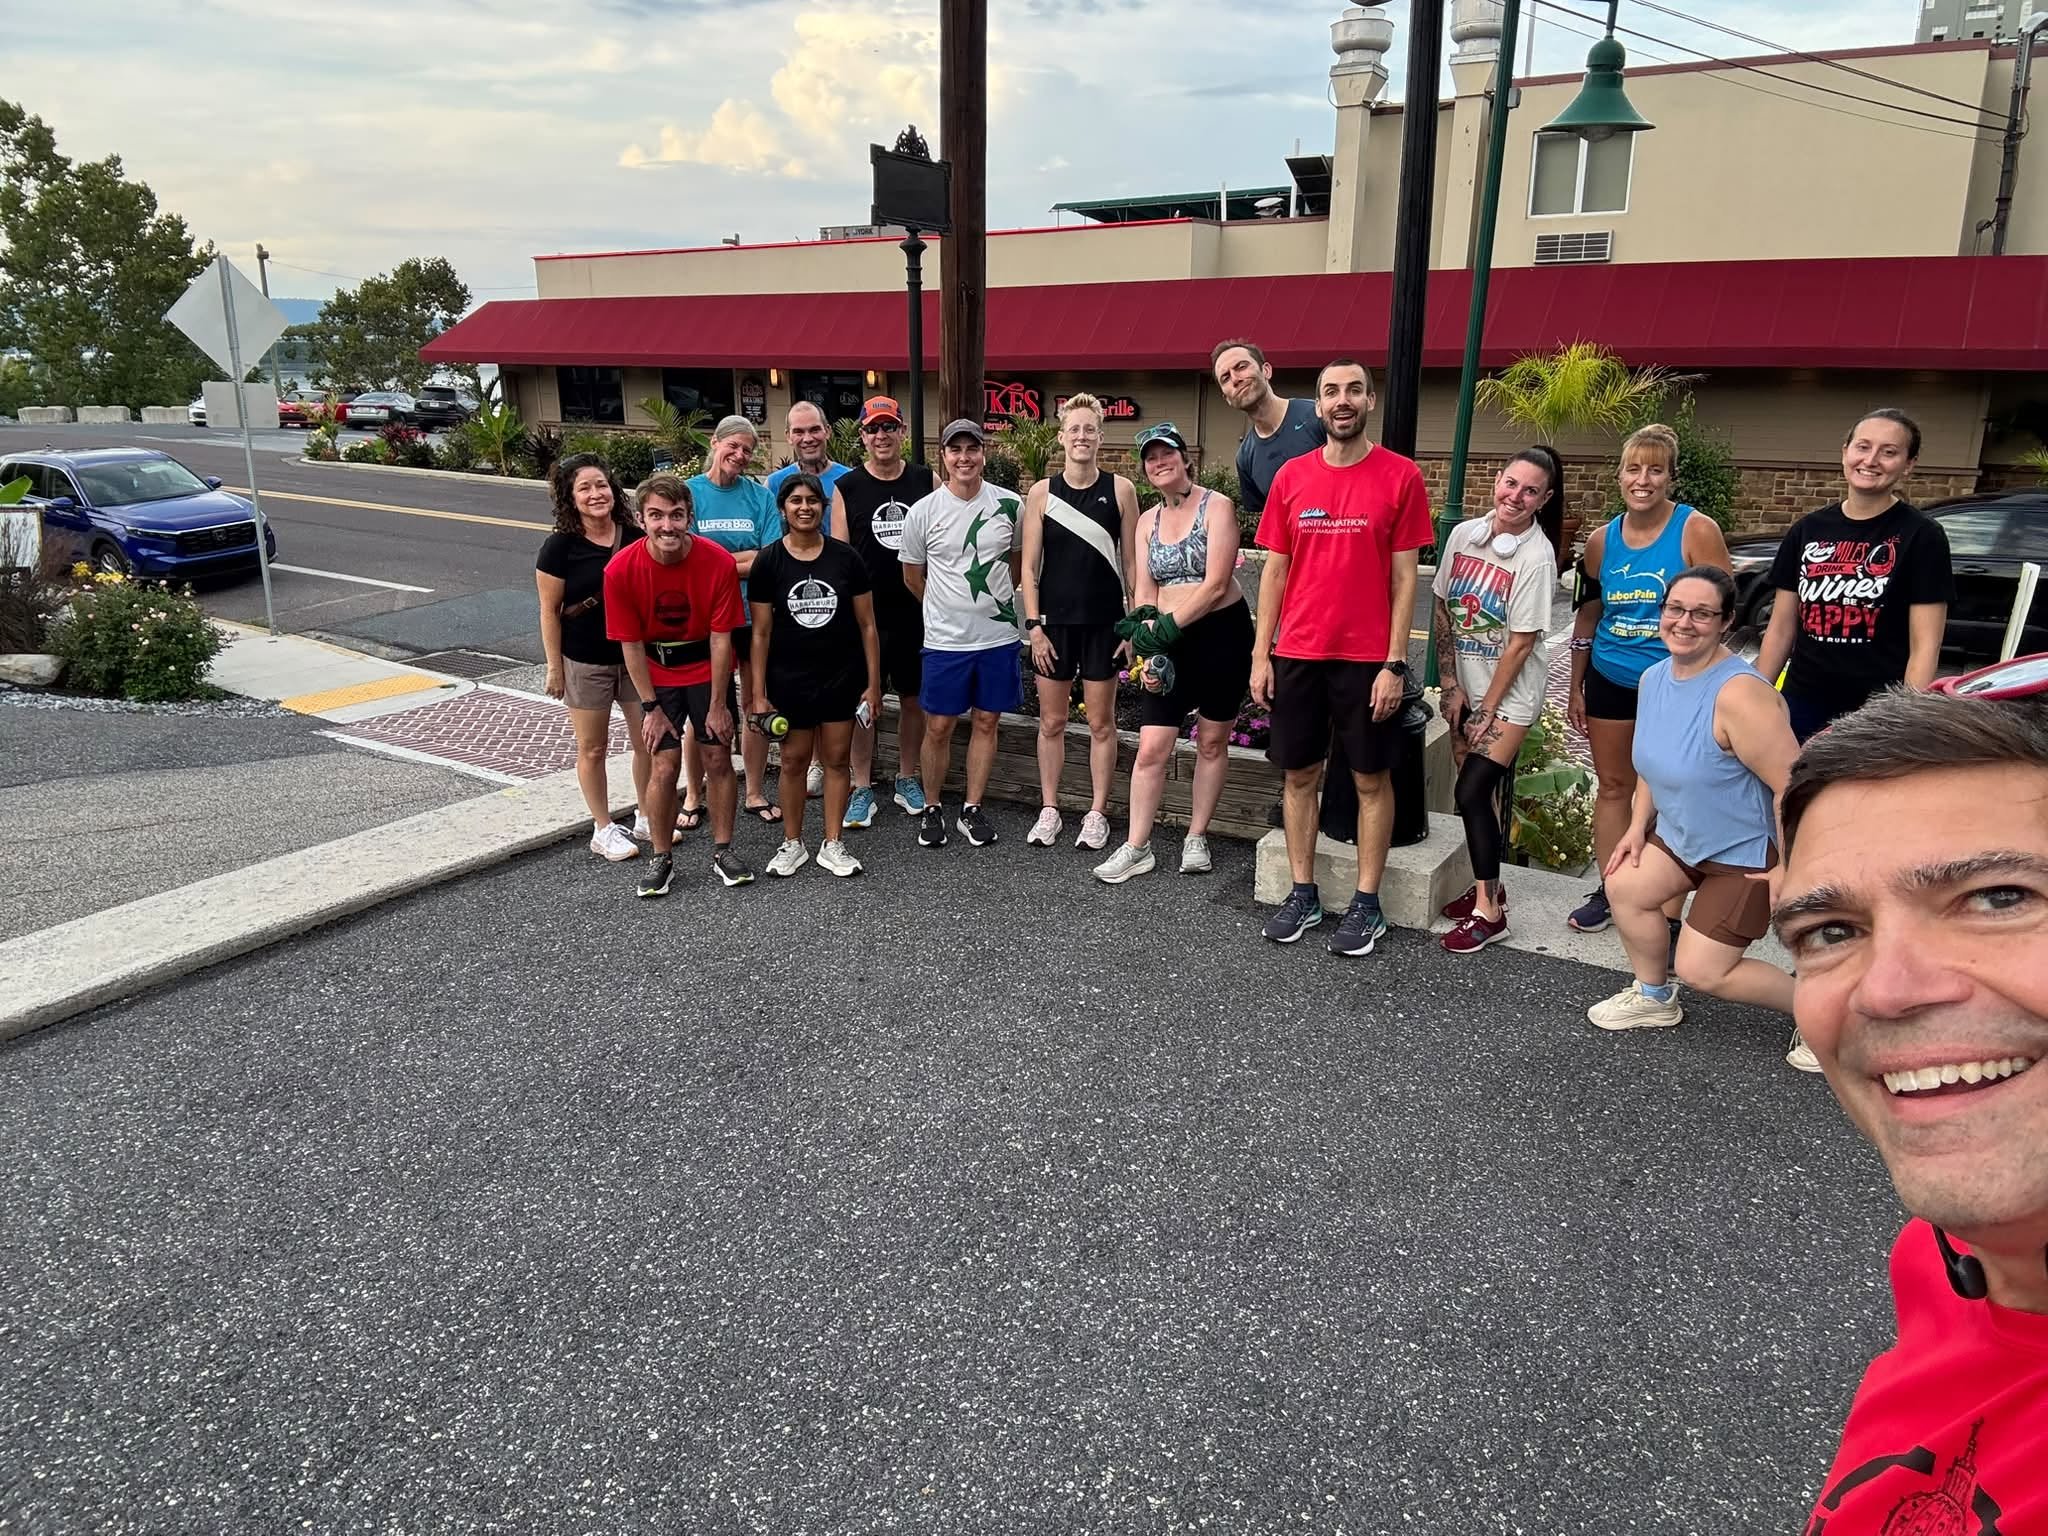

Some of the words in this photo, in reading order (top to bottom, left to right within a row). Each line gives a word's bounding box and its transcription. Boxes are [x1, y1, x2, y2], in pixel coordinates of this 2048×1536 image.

[1321, 518, 1367, 527] MARATHON
[1832, 541, 1870, 563] MILES
[1814, 564, 1845, 574] DRINK
[1842, 597, 1858, 606] BE
